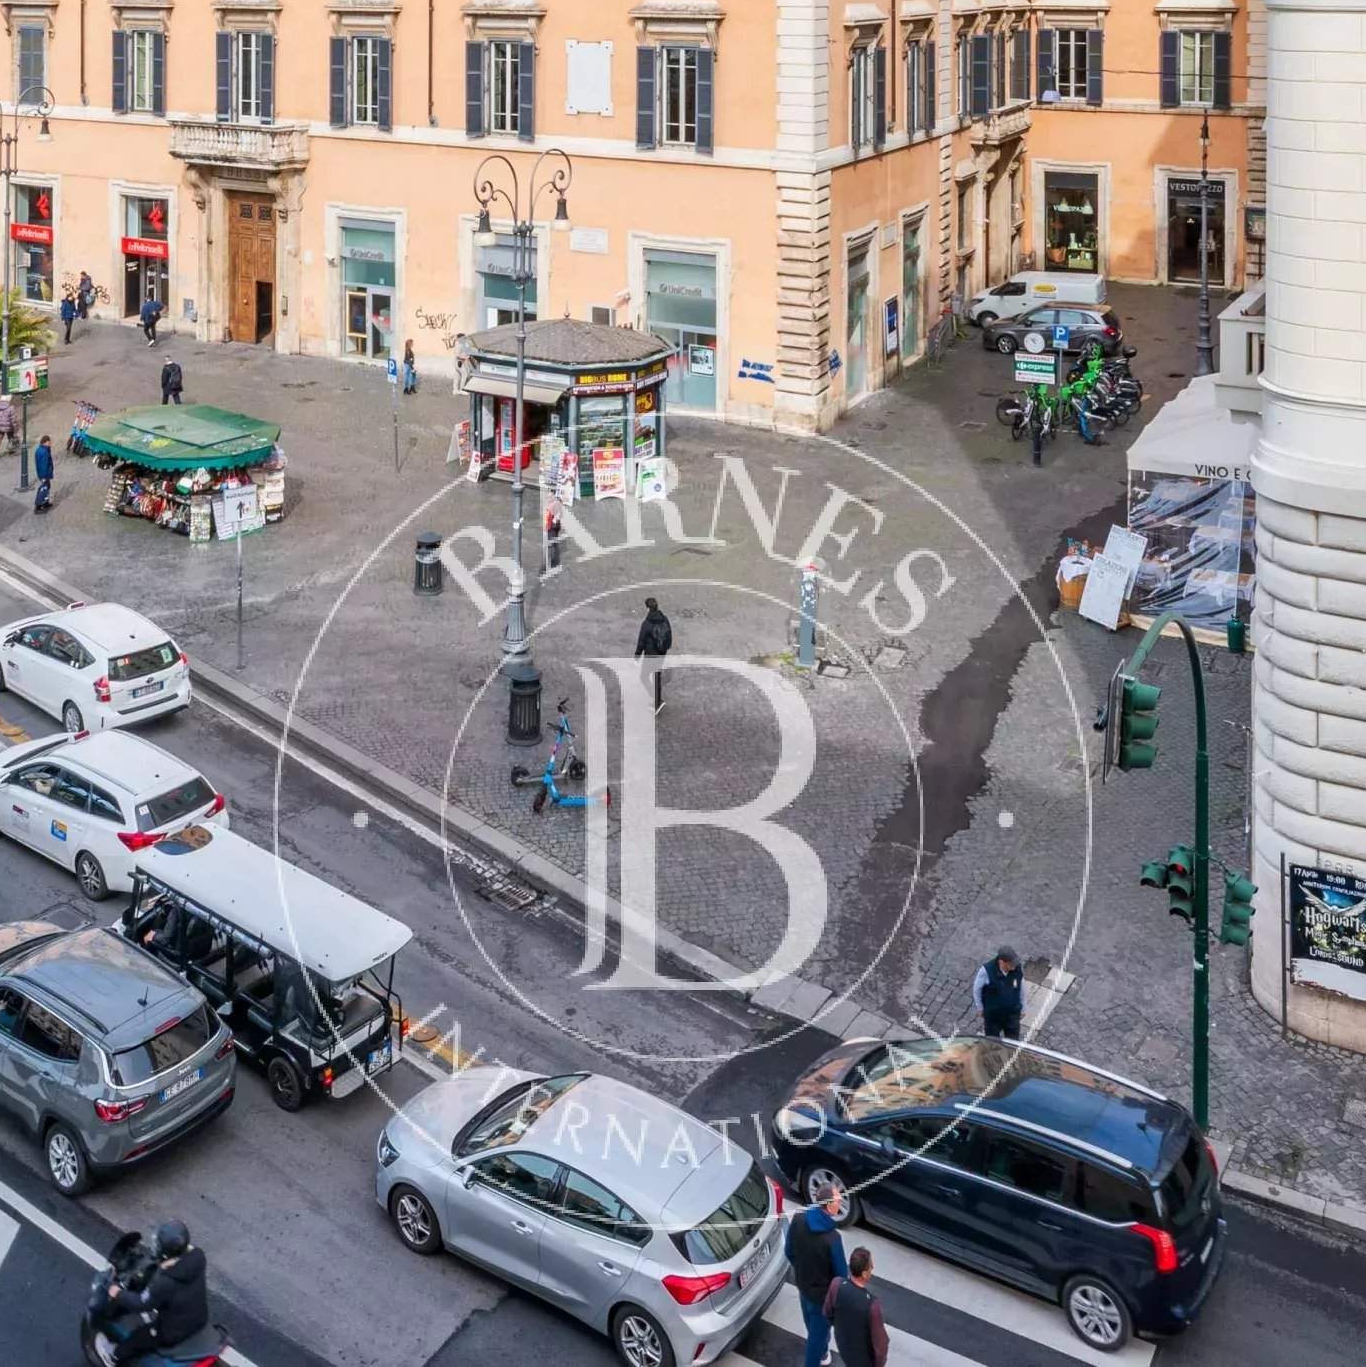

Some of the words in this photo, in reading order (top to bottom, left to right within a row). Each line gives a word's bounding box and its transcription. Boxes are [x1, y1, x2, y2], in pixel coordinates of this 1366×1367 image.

[1169, 183, 1224, 194] VESTOPZZO
[667, 284, 702, 298] UniCredit
[1056, 327, 1066, 339] P
[1195, 464, 1229, 479] VINO
[1234, 468, 1242, 480] E
